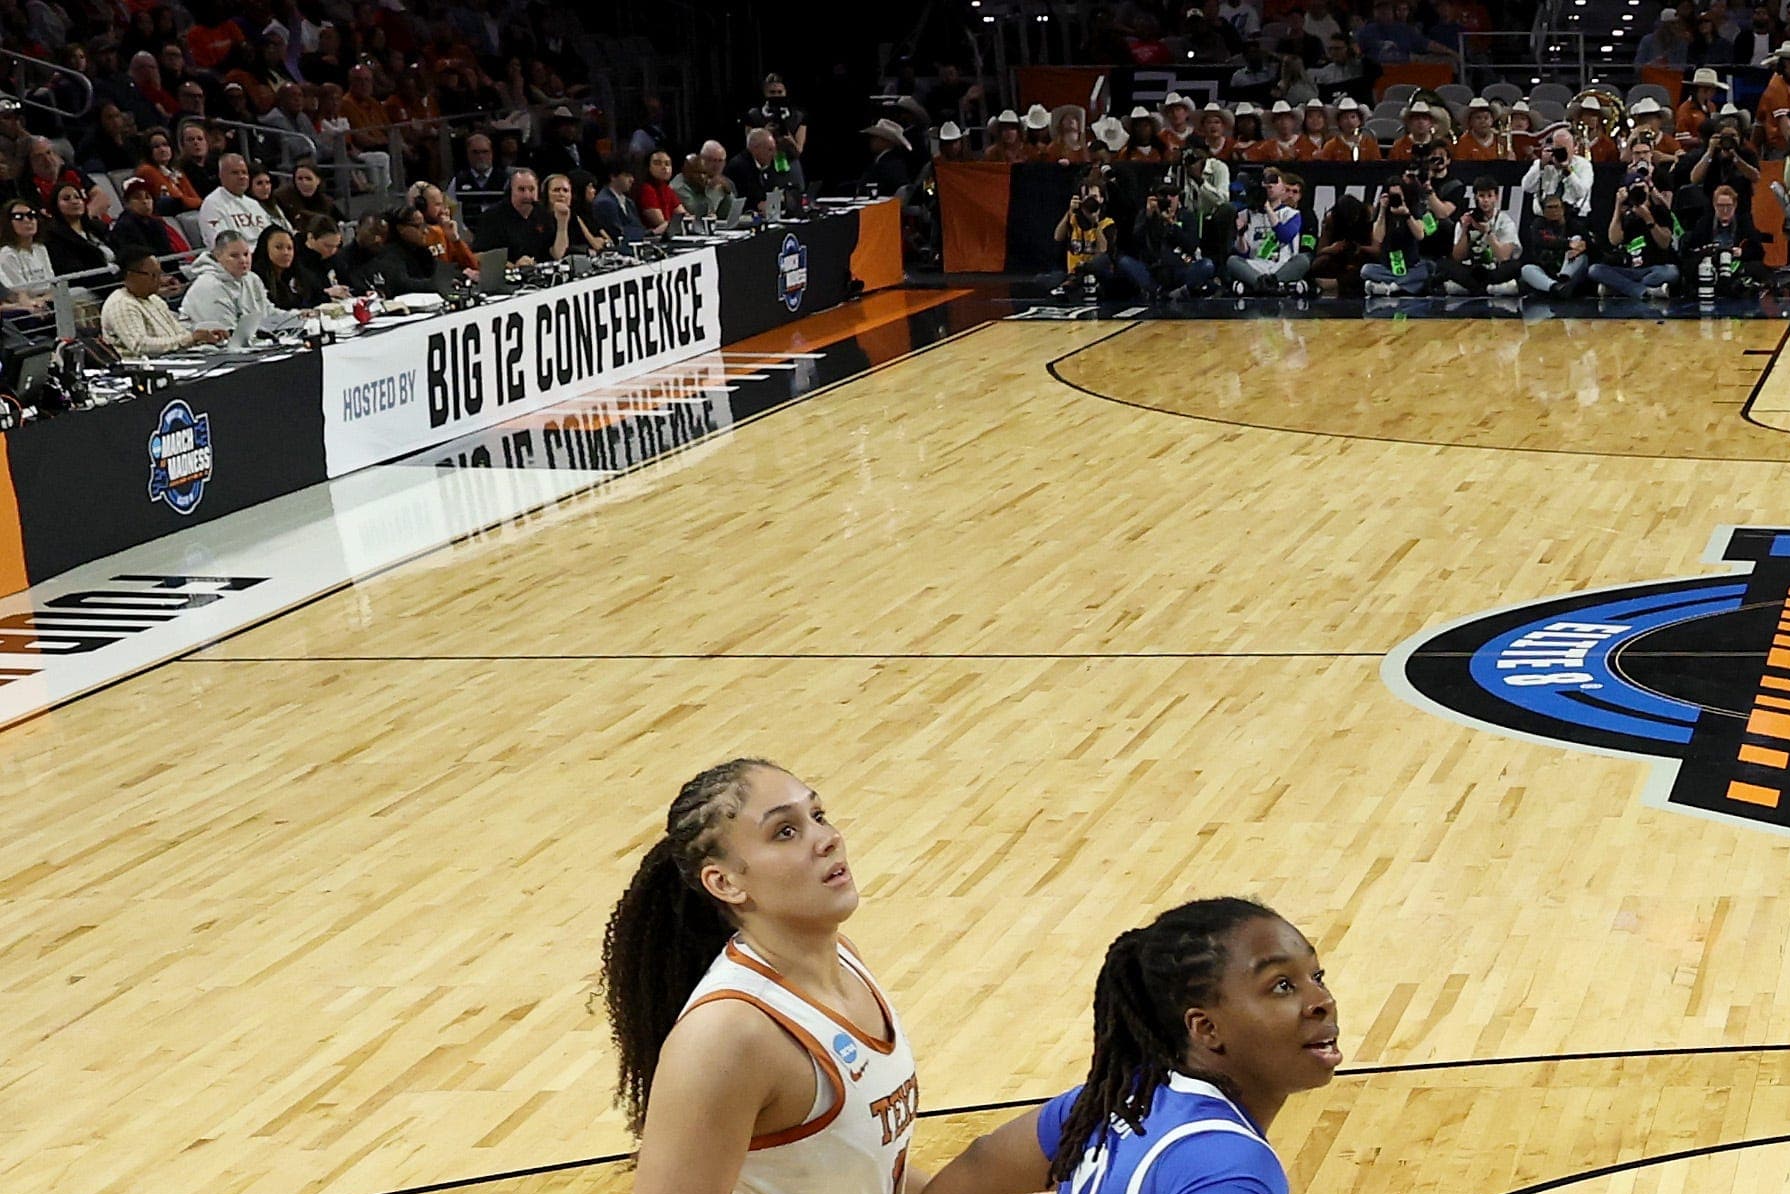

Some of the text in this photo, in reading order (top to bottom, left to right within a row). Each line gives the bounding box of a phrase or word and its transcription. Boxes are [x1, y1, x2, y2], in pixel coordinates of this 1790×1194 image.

[427, 263, 706, 429] BIG 12 CONFERENCE
[343, 368, 417, 422] HOSTED BY
[161, 427, 195, 460] MARCH
[167, 446, 211, 480] MADNESS
[1496, 622, 1633, 686] ELITE 8
[869, 1072, 919, 1146] TEX
